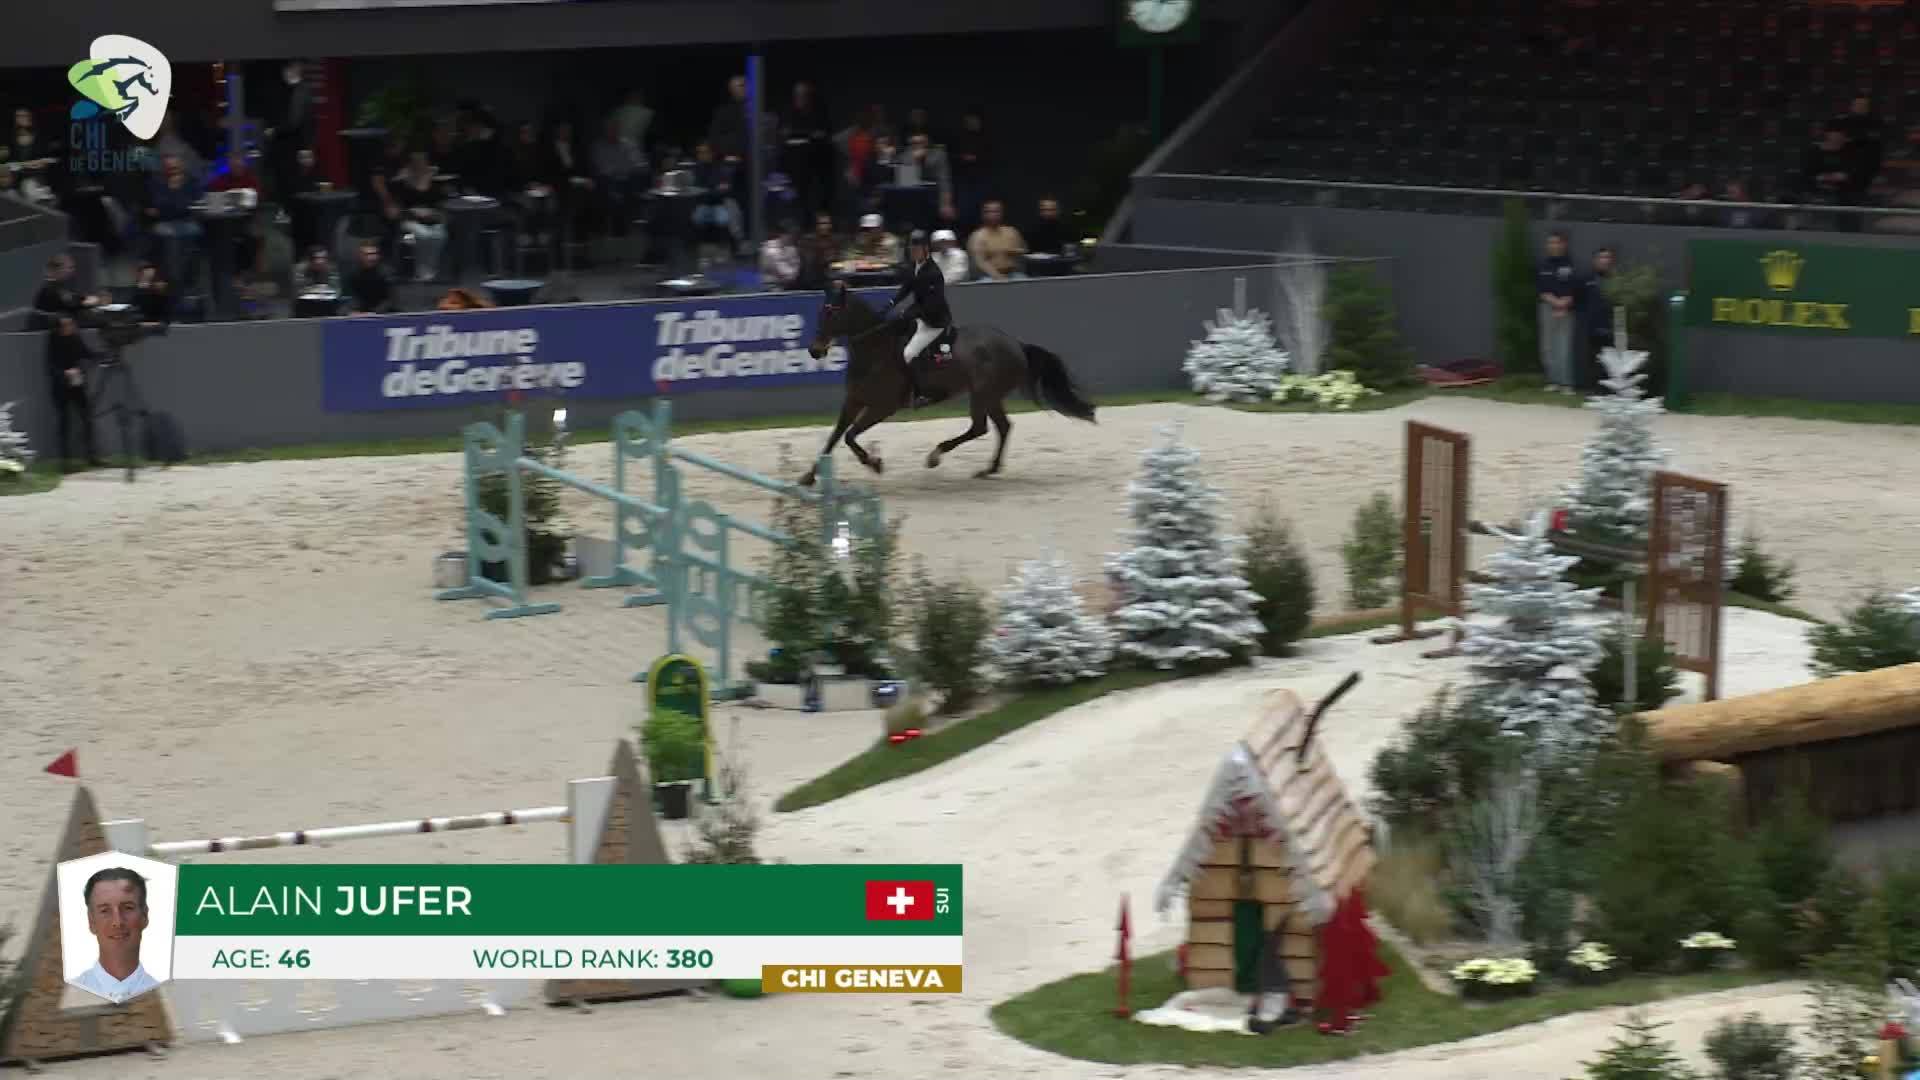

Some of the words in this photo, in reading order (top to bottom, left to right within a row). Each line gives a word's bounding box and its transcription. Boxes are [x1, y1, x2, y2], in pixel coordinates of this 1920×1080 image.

[654, 310, 804, 345] Tribune
[1712, 297, 1851, 329] ROLEX
[384, 325, 539, 361] Tribune
